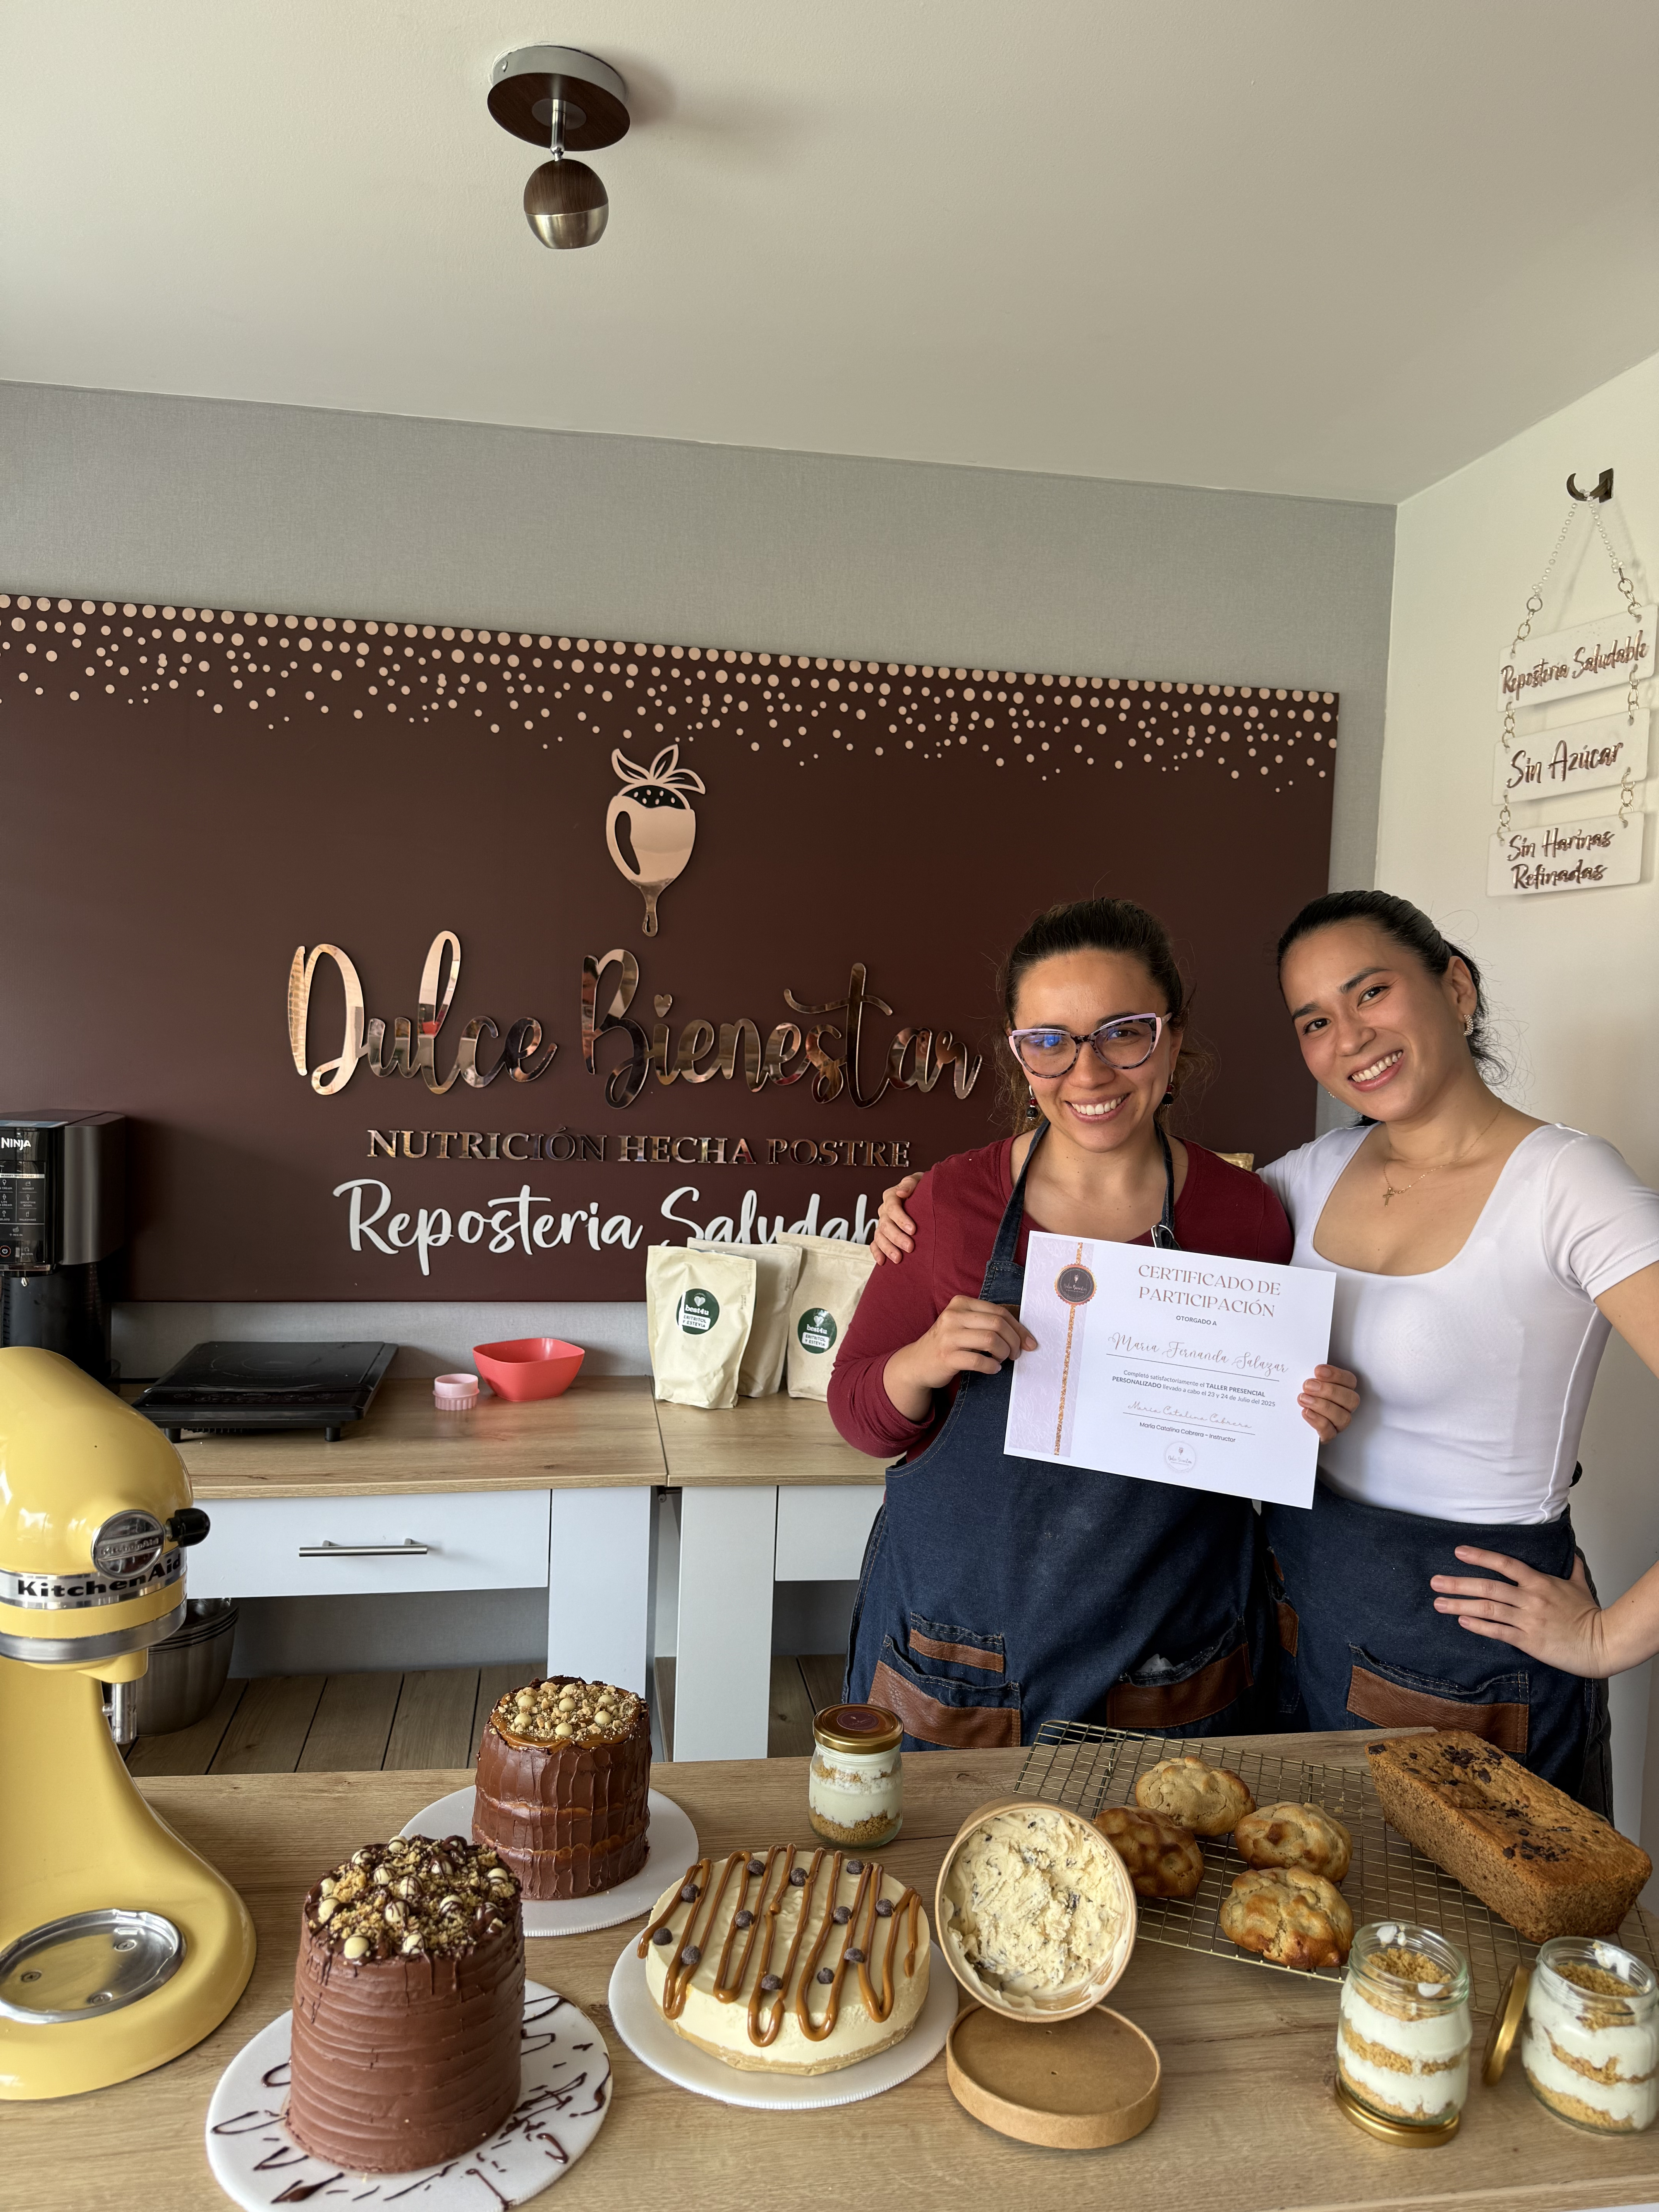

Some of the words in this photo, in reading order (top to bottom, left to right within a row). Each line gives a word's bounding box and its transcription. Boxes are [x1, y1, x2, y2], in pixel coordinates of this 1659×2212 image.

[1571, 630, 1649, 679] Saludable
[1506, 750, 1542, 788] Sin
[1547, 740, 1623, 781] Azúcar
[1506, 835, 1535, 861] Sin
[1541, 828, 1615, 858] Harinas
[1511, 859, 1608, 889] Refinadas
[287, 930, 557, 1095] Dulce
[581, 949, 982, 1109] Bienestar
[1, 1137, 31, 1151] NINJA
[367, 1125, 607, 1162] NUTRICIÓN
[620, 1135, 756, 1164] HECHA
[766, 1138, 910, 1167] POSTRE
[333, 1179, 643, 1276] Reposteria
[1138, 1264, 1254, 1291] CERTIFICADO
[1257, 1281, 1281, 1295] DE
[685, 1304, 709, 1316] best4u
[1139, 1286, 1274, 1317] PARTICIPACIÓN
[807, 1324, 828, 1334] best4u
[1176, 1315, 1211, 1325] OTORGADO
[805, 1334, 826, 1342] ERITRITOL
[1162, 1341, 1229, 1363] Fernanda
[1231, 1352, 1288, 1377] Salazar
[1112, 1376, 1162, 1388] PERSONALIZADO
[1124, 1370, 1149, 1379] Completó
[1150, 1375, 1199, 1386] satisfactoriamente
[1206, 1382, 1228, 1391] TALLER
[1229, 1386, 1266, 1397] PRESENCIAL
[1163, 1405, 1207, 1420] Catalina
[1209, 1413, 1252, 1428] Cabrera
[1156, 1425, 1180, 1433] Catalina
[1181, 1429, 1204, 1437] Cabrera
[1209, 1433, 1236, 1442] Instructor
[17, 1553, 181, 1597] KitchenAid
